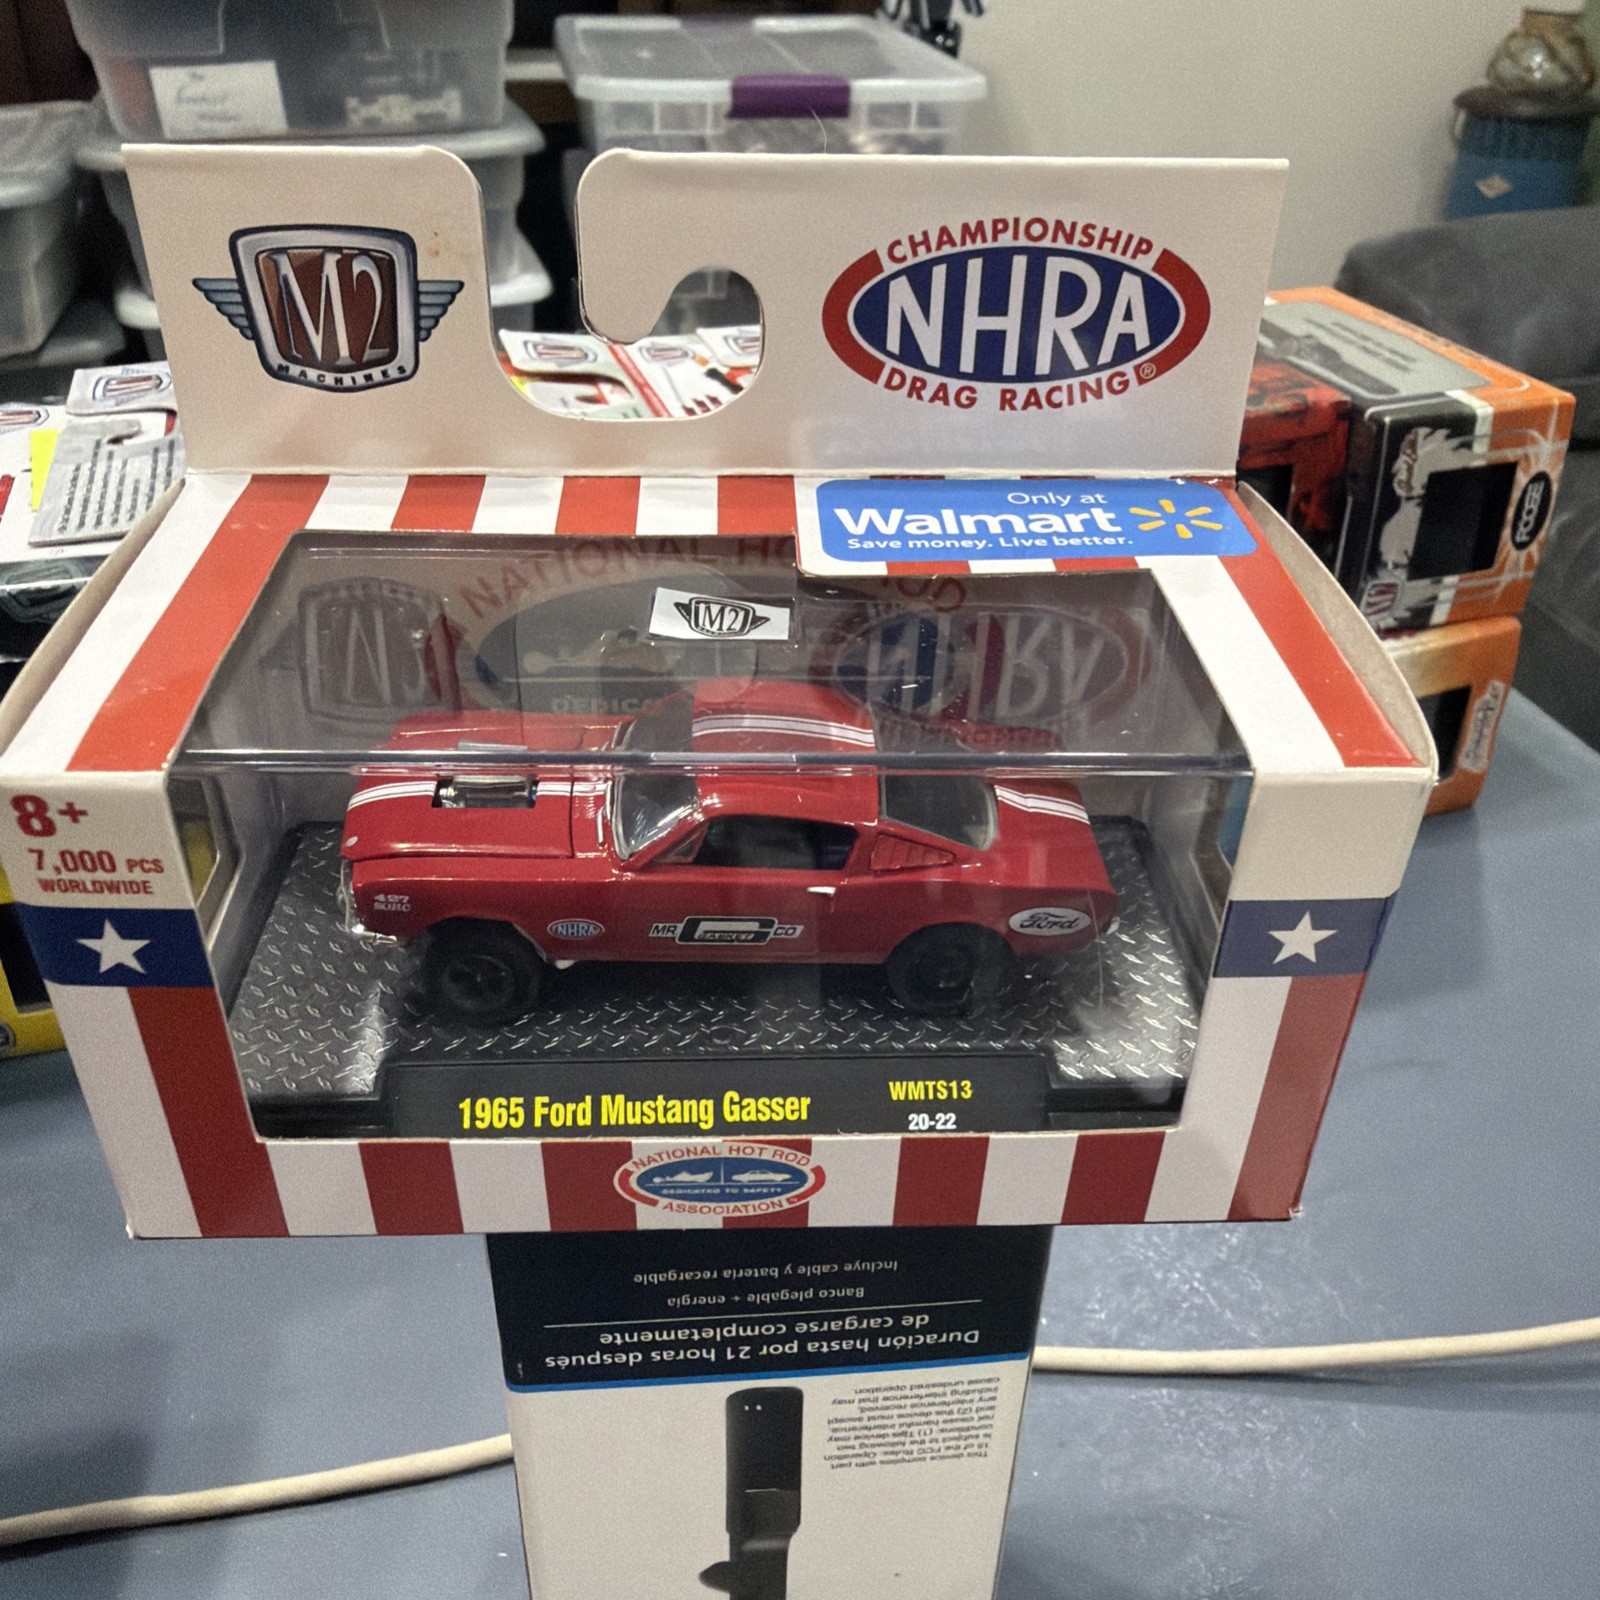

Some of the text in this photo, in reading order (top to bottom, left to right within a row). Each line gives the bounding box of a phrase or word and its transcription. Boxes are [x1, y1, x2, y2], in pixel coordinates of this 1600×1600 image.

[886, 216, 1154, 265] CHAMPIONSHIP
[266, 249, 390, 366] M2
[885, 253, 1151, 377] NHRA
[277, 364, 407, 386] MACHINES
[884, 366, 1131, 412] DRAG RACING
[1007, 491, 1108, 507] Only at
[833, 506, 1123, 536] Walmart
[847, 535, 1134, 550] Save money. Live better.
[702, 602, 740, 632] M2
[10, 794, 88, 838] 8+
[27, 848, 165, 875] 7,000 PCS
[38, 878, 154, 895] WORLDWIDE
[557, 923, 597, 936] NHRA
[1019, 912, 1080, 929] Ford
[651, 924, 677, 936] MR
[773, 926, 797, 937] CO
[889, 1080, 973, 1101] WMTS13
[458, 1090, 812, 1130] 1965 Ford Mustang Gasser
[907, 1112, 957, 1131] 20-22
[631, 1145, 811, 1170] NATIONAL HOT ROD
[662, 1200, 784, 1215] ASSOCIATION
[783, 1263, 792, 1276] y
[798, 1263, 838, 1276] cable
[844, 1260, 898, 1273] Incluye
[633, 1269, 718, 1285] recargable
[667, 1293, 726, 1309] energía
[747, 1287, 813, 1306] plegable
[818, 1286, 865, 1298] Banco
[599, 1314, 930, 1346] de cargarse completamente
[544, 1329, 980, 1369] Duración hasta por 21 horas después
